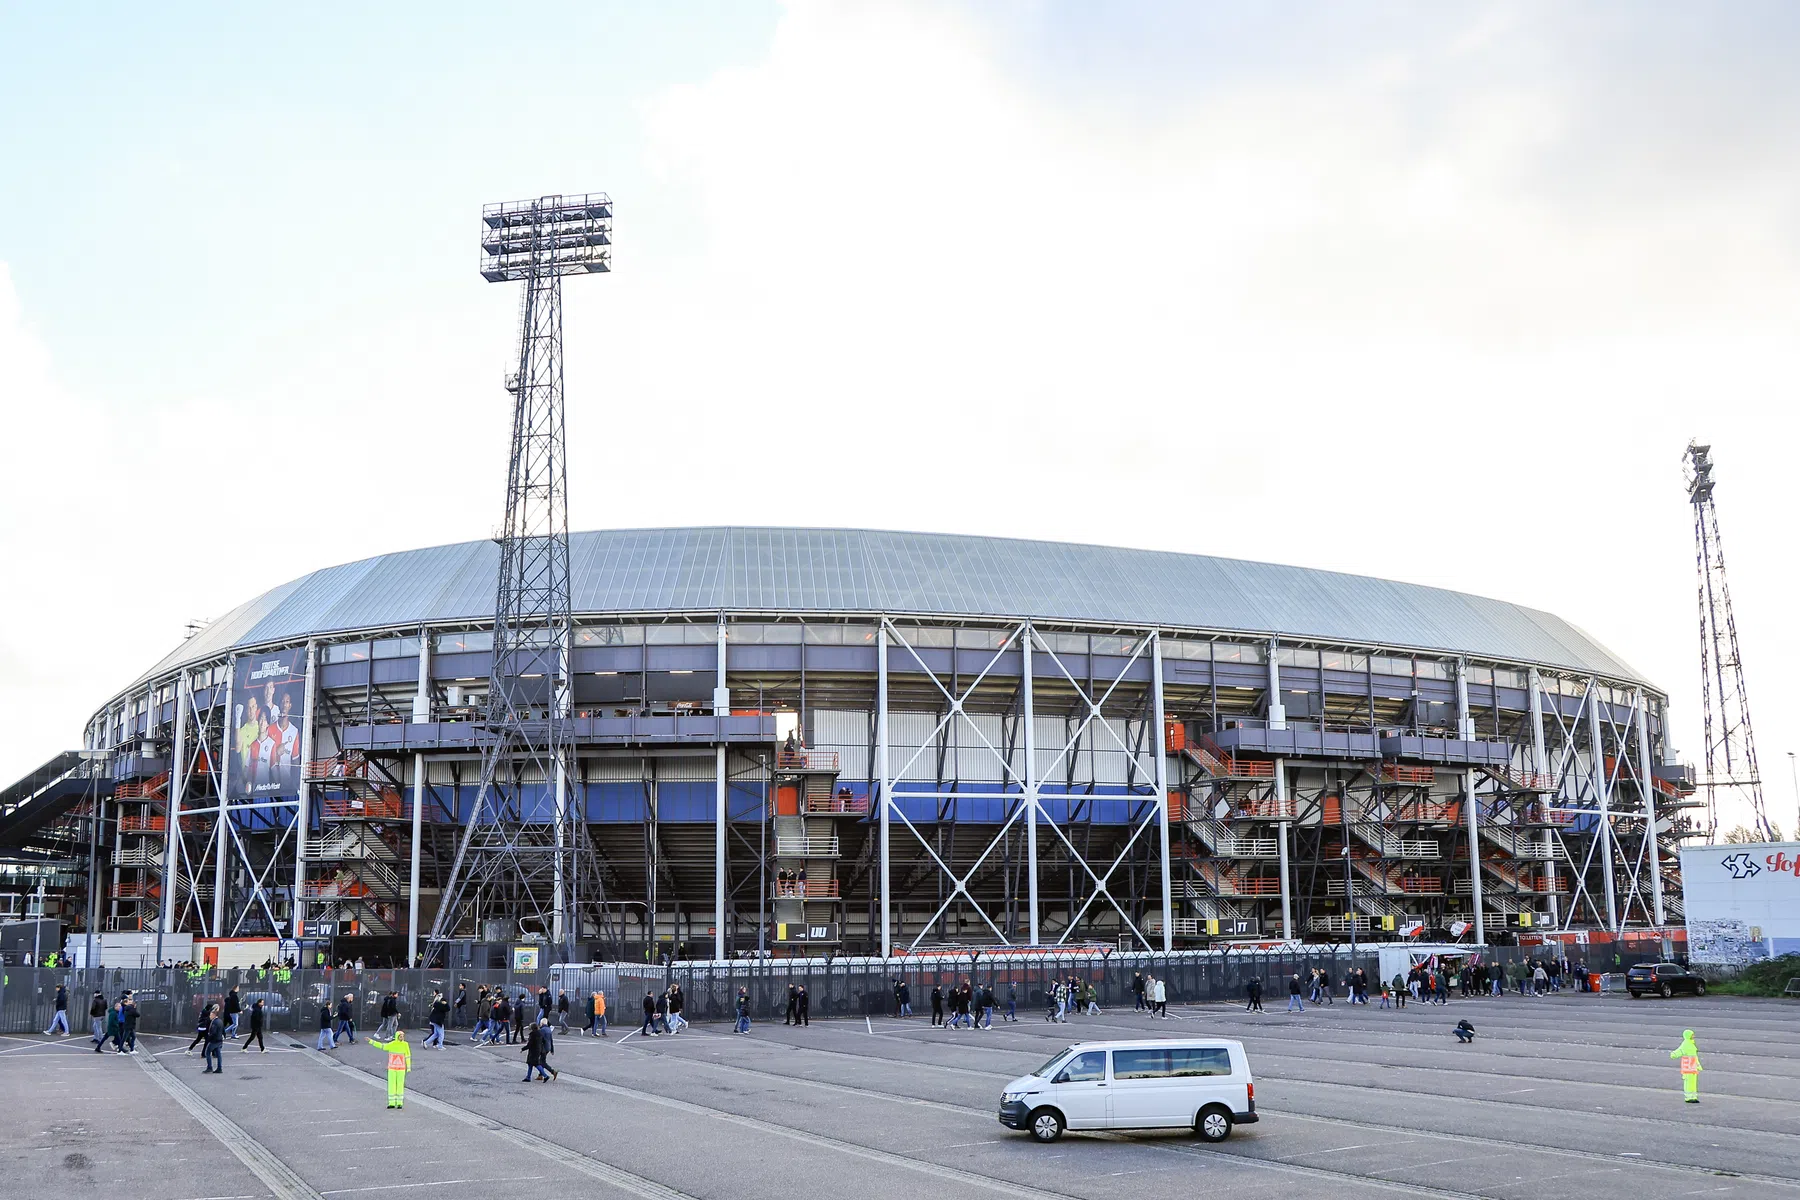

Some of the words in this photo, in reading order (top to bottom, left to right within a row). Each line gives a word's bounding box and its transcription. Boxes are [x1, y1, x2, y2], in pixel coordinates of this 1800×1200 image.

[262, 660, 280, 671] TROTSE
[810, 927, 827, 938] UU
[1237, 922, 1248, 932] TT
